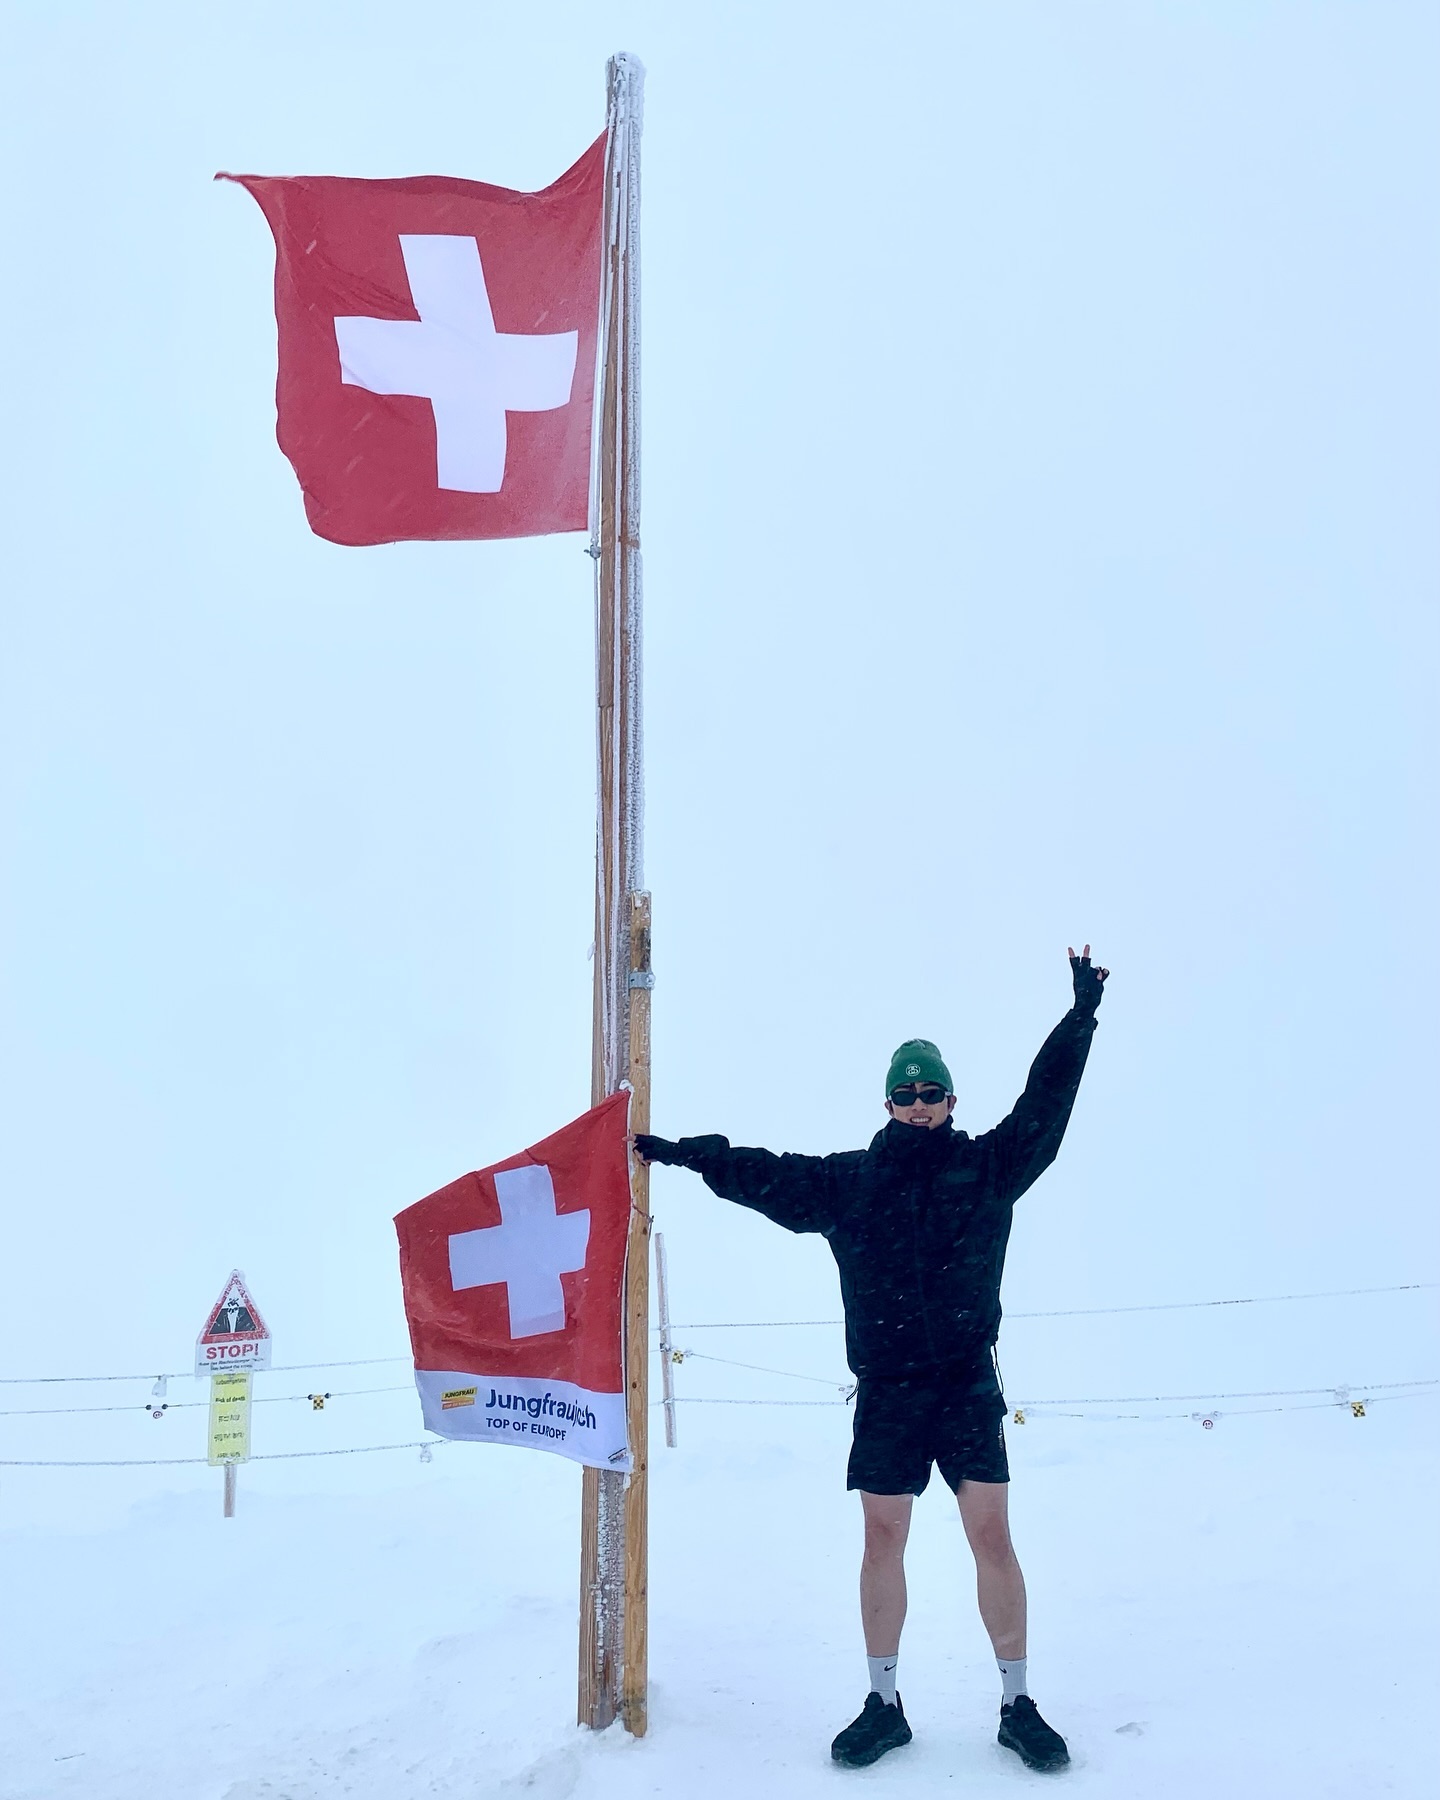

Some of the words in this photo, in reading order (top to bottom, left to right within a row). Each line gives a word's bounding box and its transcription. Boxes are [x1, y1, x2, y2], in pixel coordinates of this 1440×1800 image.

[206, 1343, 259, 1359] STOP!
[444, 1388, 475, 1398] JUNGFRAU
[486, 1417, 510, 1429] TOP
[512, 1420, 528, 1432] OF
[531, 1423, 567, 1441] EUROPE
